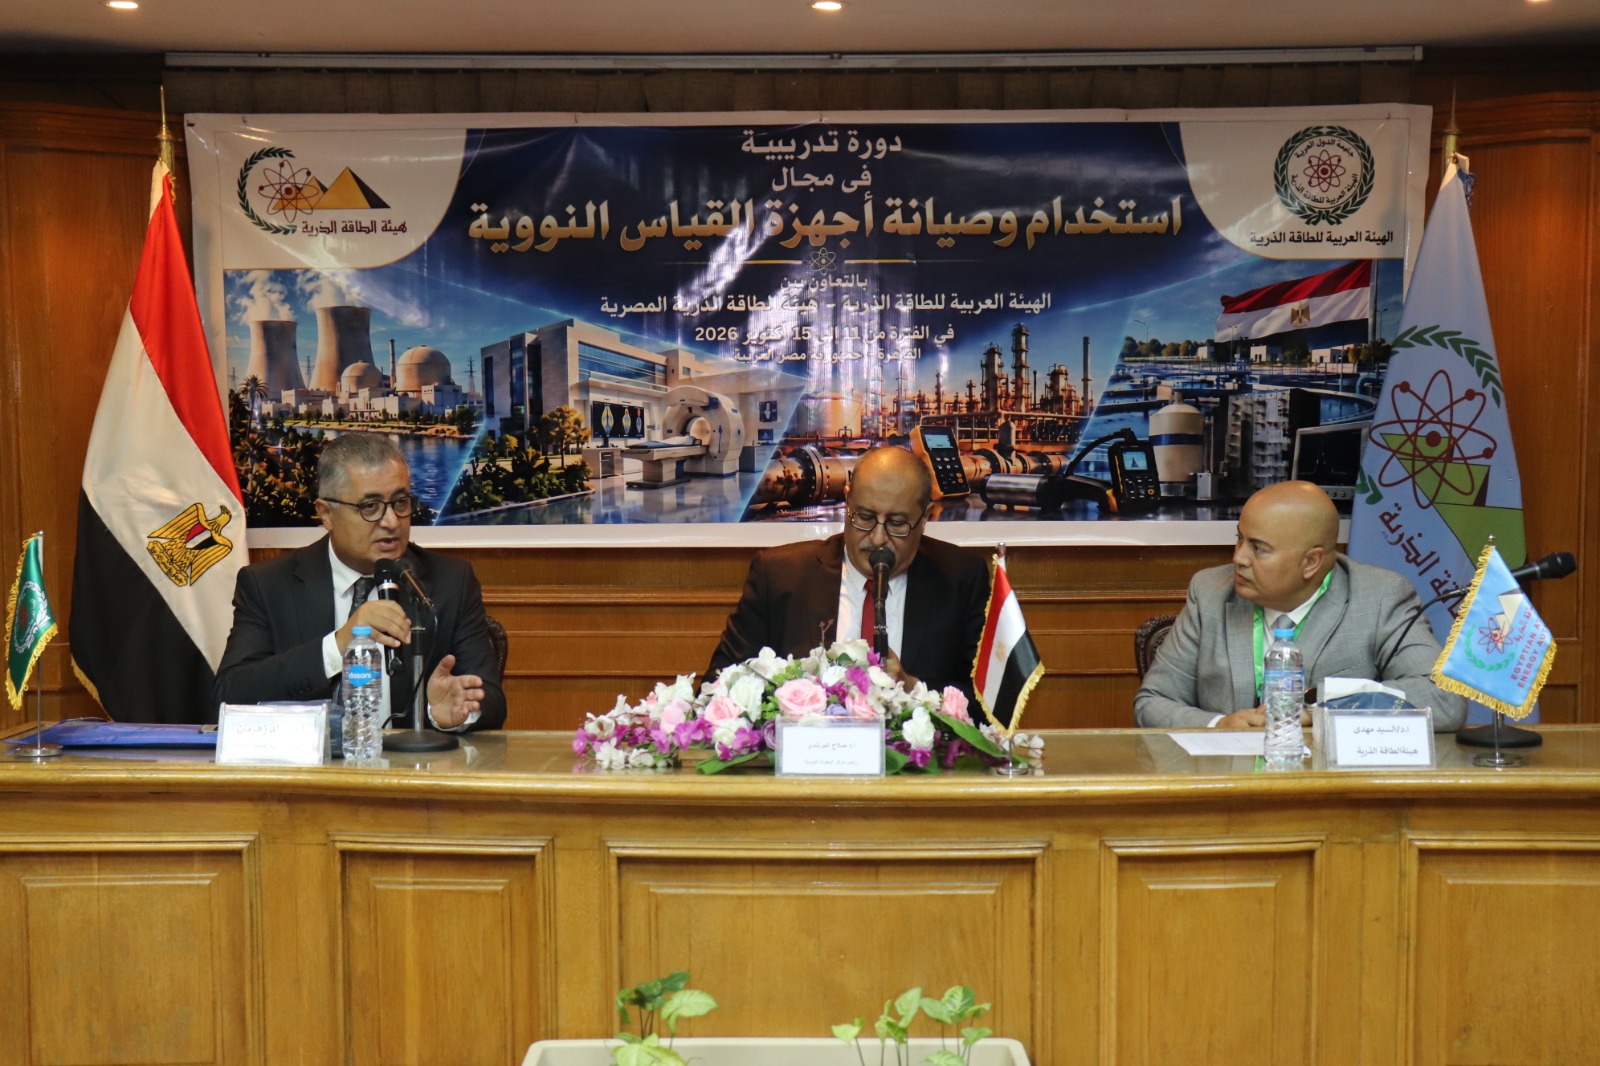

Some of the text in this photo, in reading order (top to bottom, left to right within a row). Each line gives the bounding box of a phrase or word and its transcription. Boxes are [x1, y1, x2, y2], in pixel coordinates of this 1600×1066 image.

[741, 129, 902, 160] دورة تدريبية
[772, 166, 835, 193] مجال
[301, 219, 408, 237] هيئة الطاقة الذرية
[468, 190, 1183, 253] استخدام وصيانة أجهزة القياس النووية
[1250, 230, 1394, 247] الهيئة العربية للطاقة الذرية
[808, 273, 868, 293] بالتعاون
[600, 295, 668, 318] المصرية
[781, 294, 818, 315] هيئة
[842, 292, 891, 316] الذرية
[895, 292, 946, 312] للطاقة
[950, 292, 1004, 315] العربية
[1008, 292, 1052, 315] الهيئة
[695, 326, 739, 341] 2026
[792, 326, 811, 341] 15
[843, 326, 861, 340] 11
[864, 329, 886, 344] من
[890, 325, 930, 344] الفترة
[776, 351, 807, 365] مصر
[1379, 502, 1440, 577] الذرية
[1510, 632, 1537, 681] EGYPTIAN
[1517, 628, 1548, 688] ENERGY AUT
